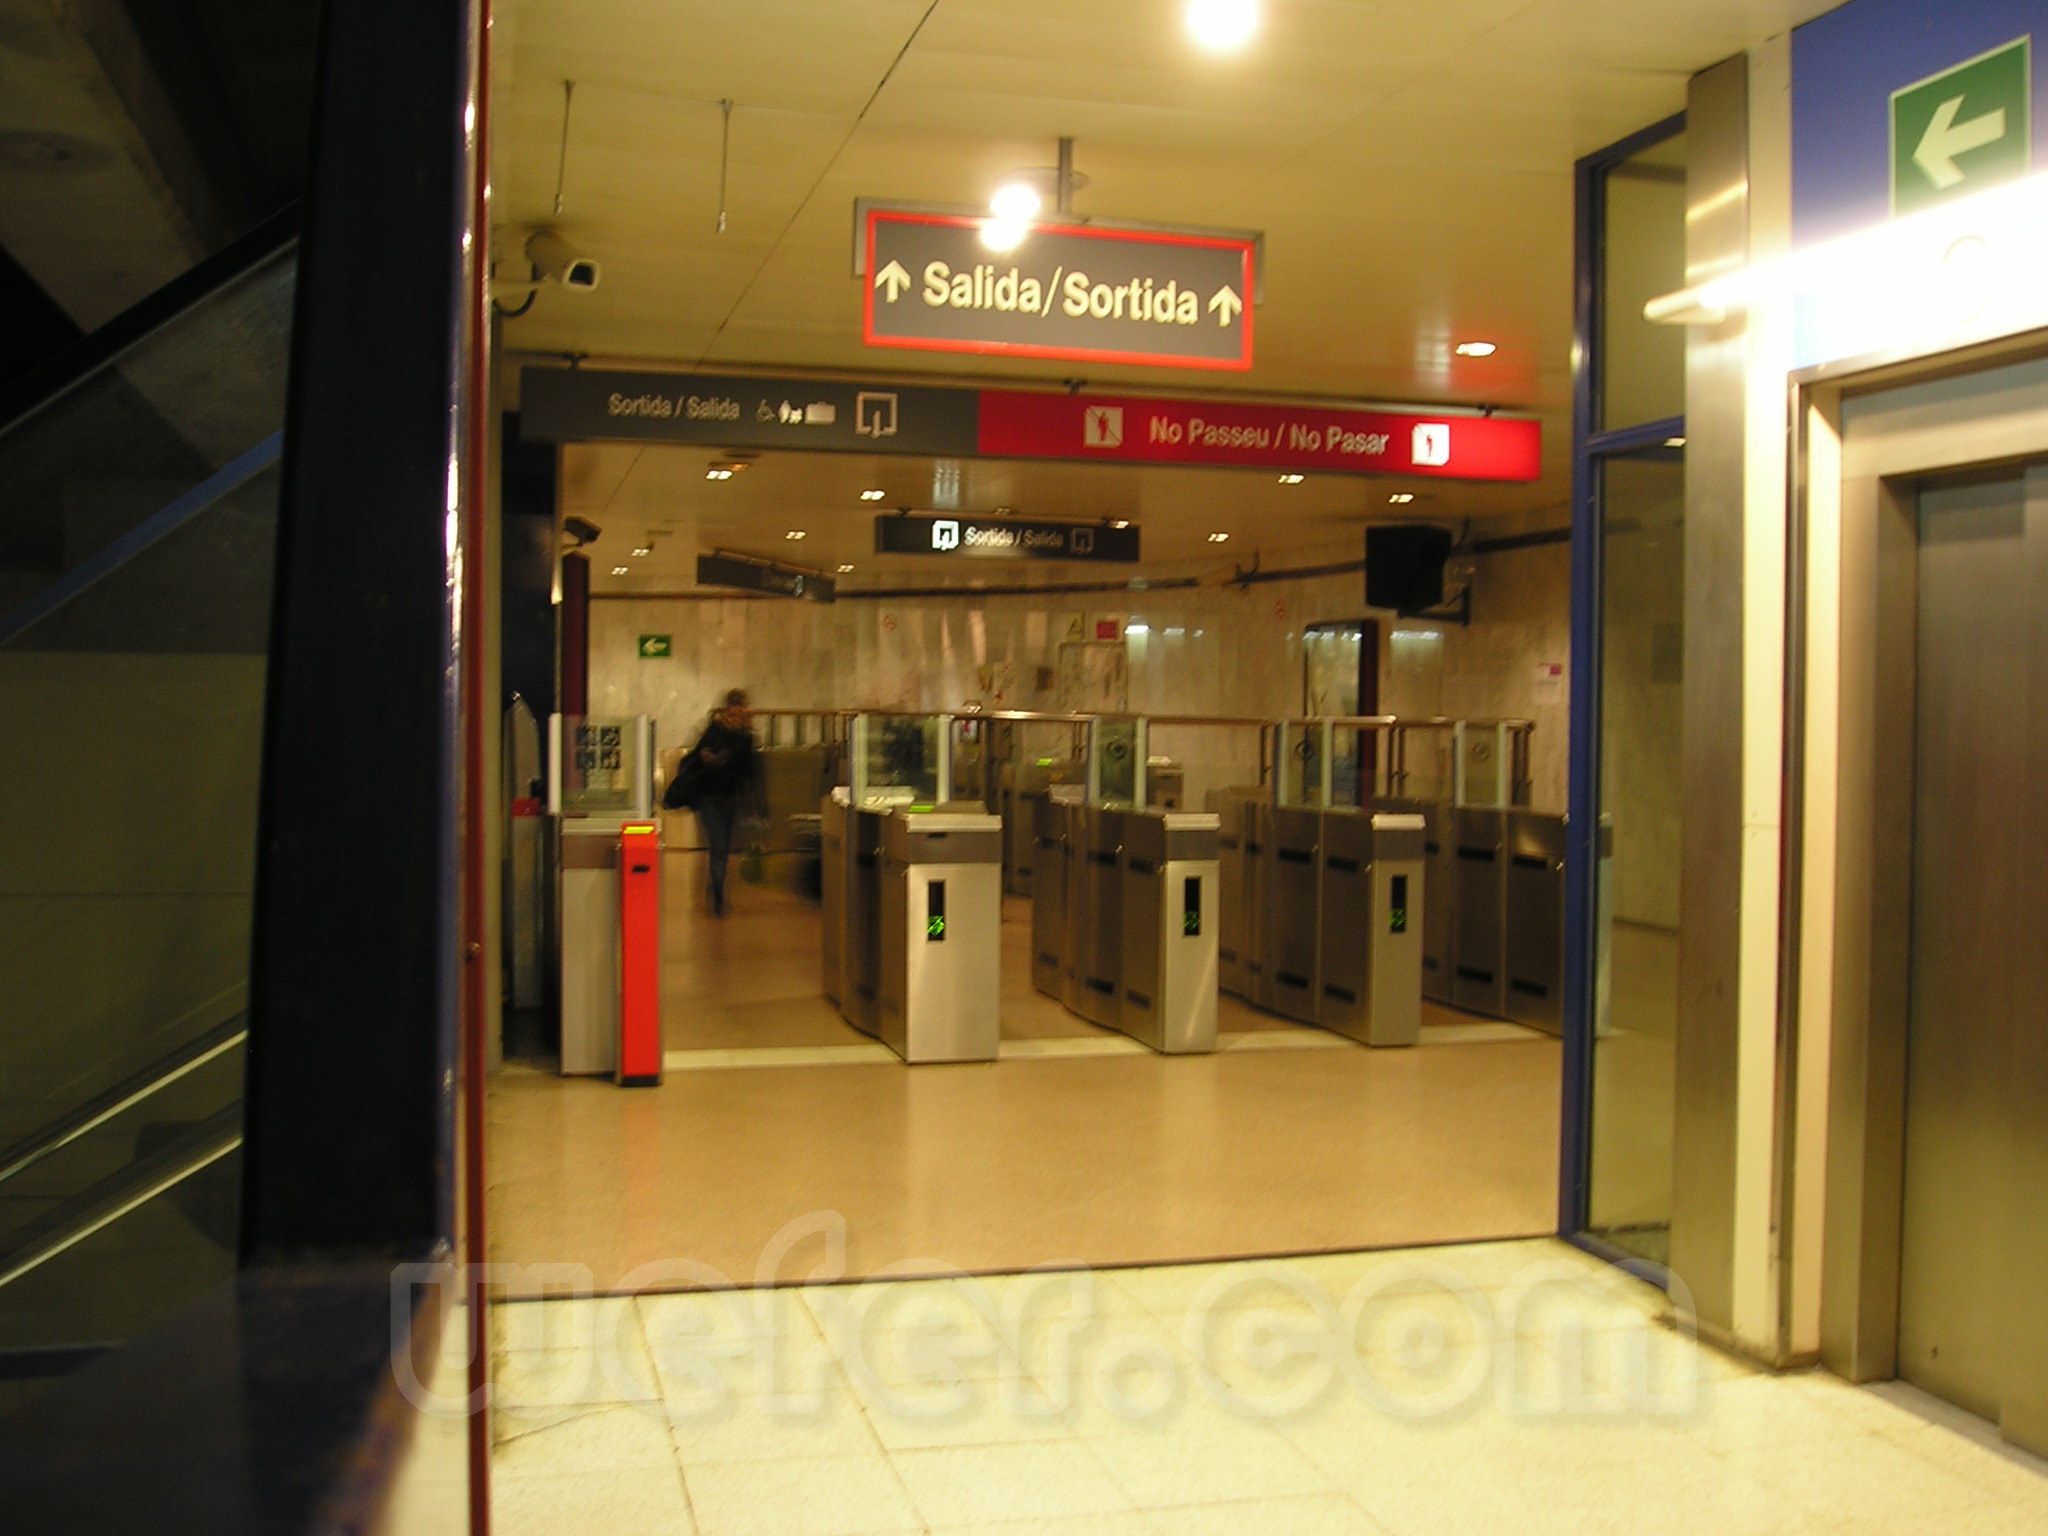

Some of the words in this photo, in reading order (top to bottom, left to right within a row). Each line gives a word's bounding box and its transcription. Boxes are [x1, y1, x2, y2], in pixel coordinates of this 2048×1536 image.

[922, 260, 1199, 325] Salida/Sortida
[608, 393, 673, 418] Sortida
[686, 396, 741, 421] Salida
[1150, 416, 1182, 444] No
[1188, 418, 1270, 450] Passeu
[1289, 423, 1321, 450] No
[1326, 425, 1391, 455] Pasar
[964, 525, 1014, 548] Sortida
